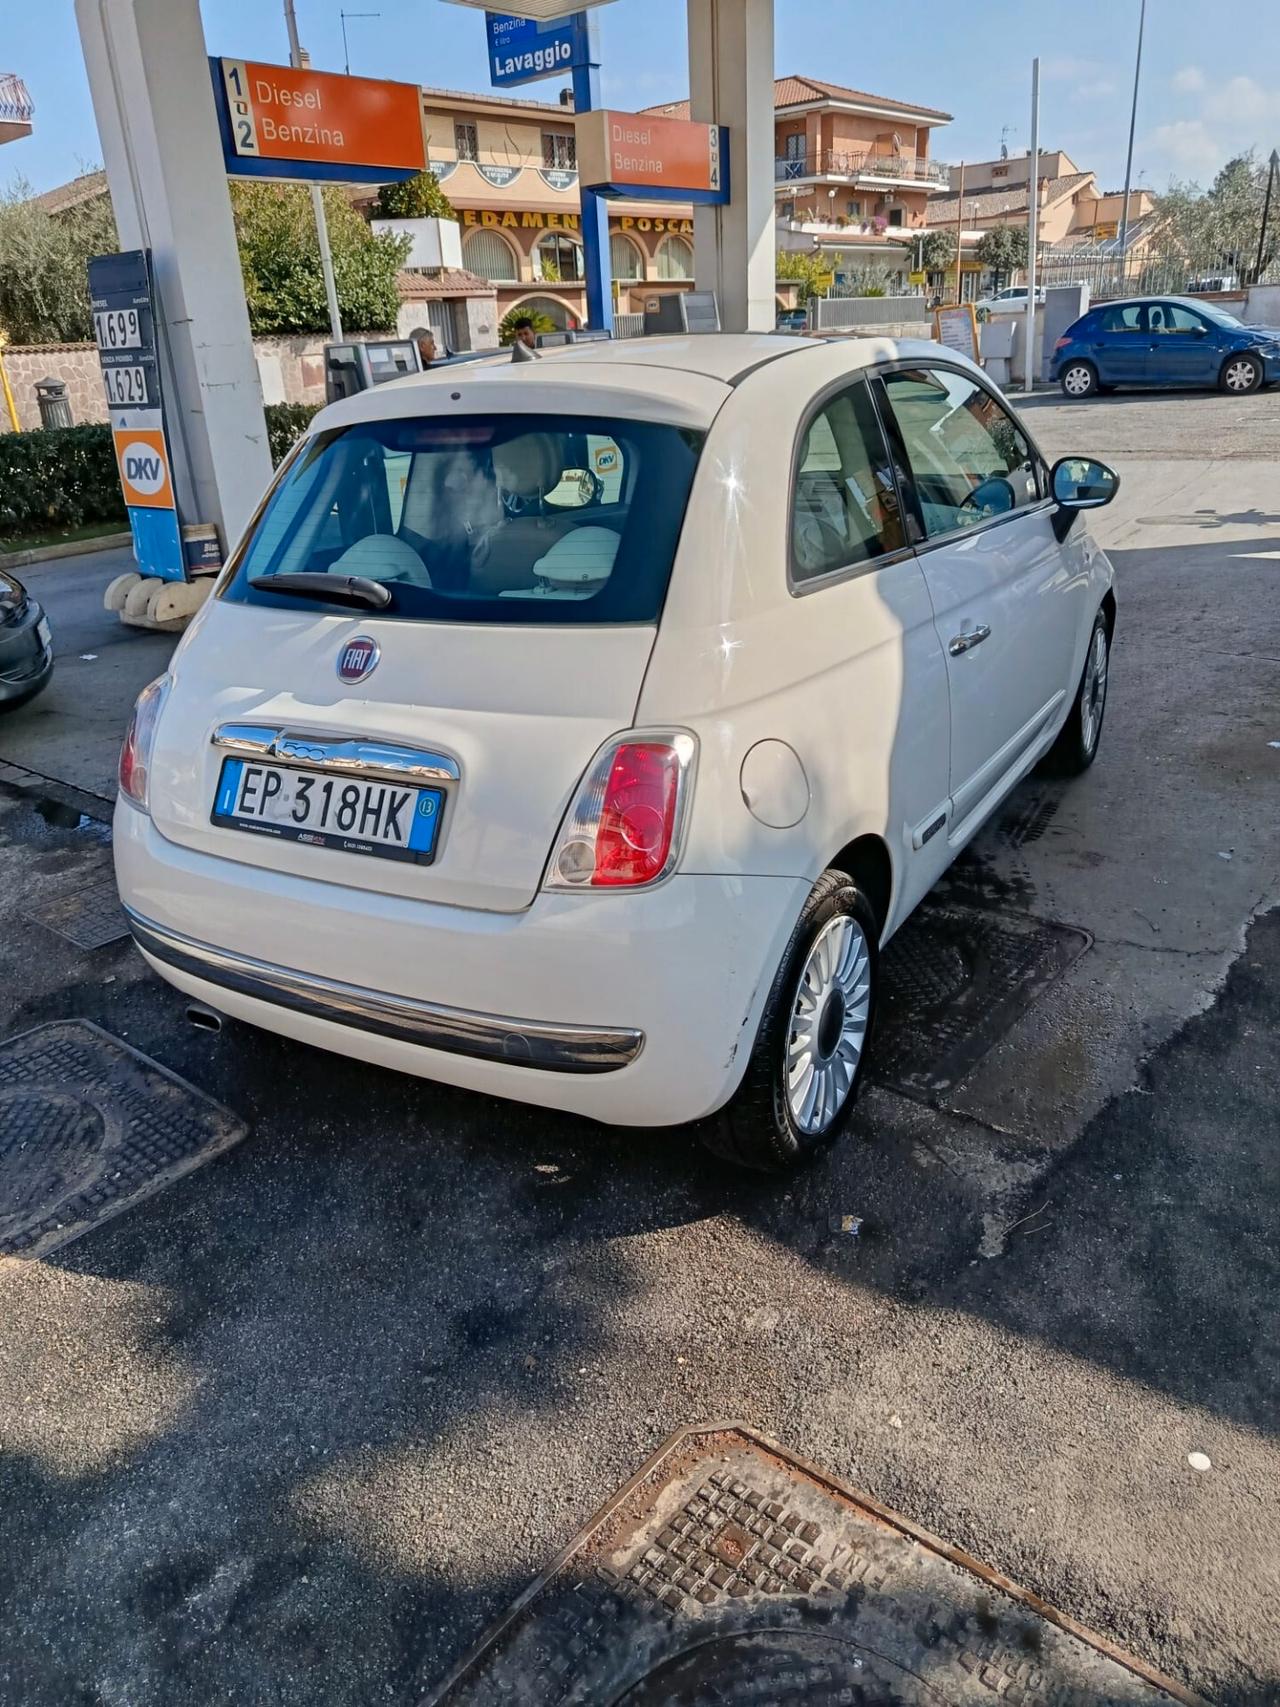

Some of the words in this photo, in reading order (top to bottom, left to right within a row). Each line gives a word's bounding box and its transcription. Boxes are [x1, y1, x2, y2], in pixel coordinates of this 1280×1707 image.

[495, 40, 571, 76] Lavaggio
[229, 67, 242, 96] 1
[256, 80, 321, 110] Diesel
[238, 120, 254, 148] 2
[262, 117, 344, 146] Benzina
[612, 124, 651, 145] Diesel
[710, 128, 717, 147] 3
[614, 152, 663, 173] Benzina
[710, 168, 718, 186] 4
[464, 210, 578, 230] EDAMEN
[126, 457, 160, 480] DKV
[599, 454, 615, 466] DKV
[343, 648, 371, 670] FIAT
[283, 742, 326, 761] 500
[238, 768, 282, 816] EP
[291, 776, 411, 841] 318HK
